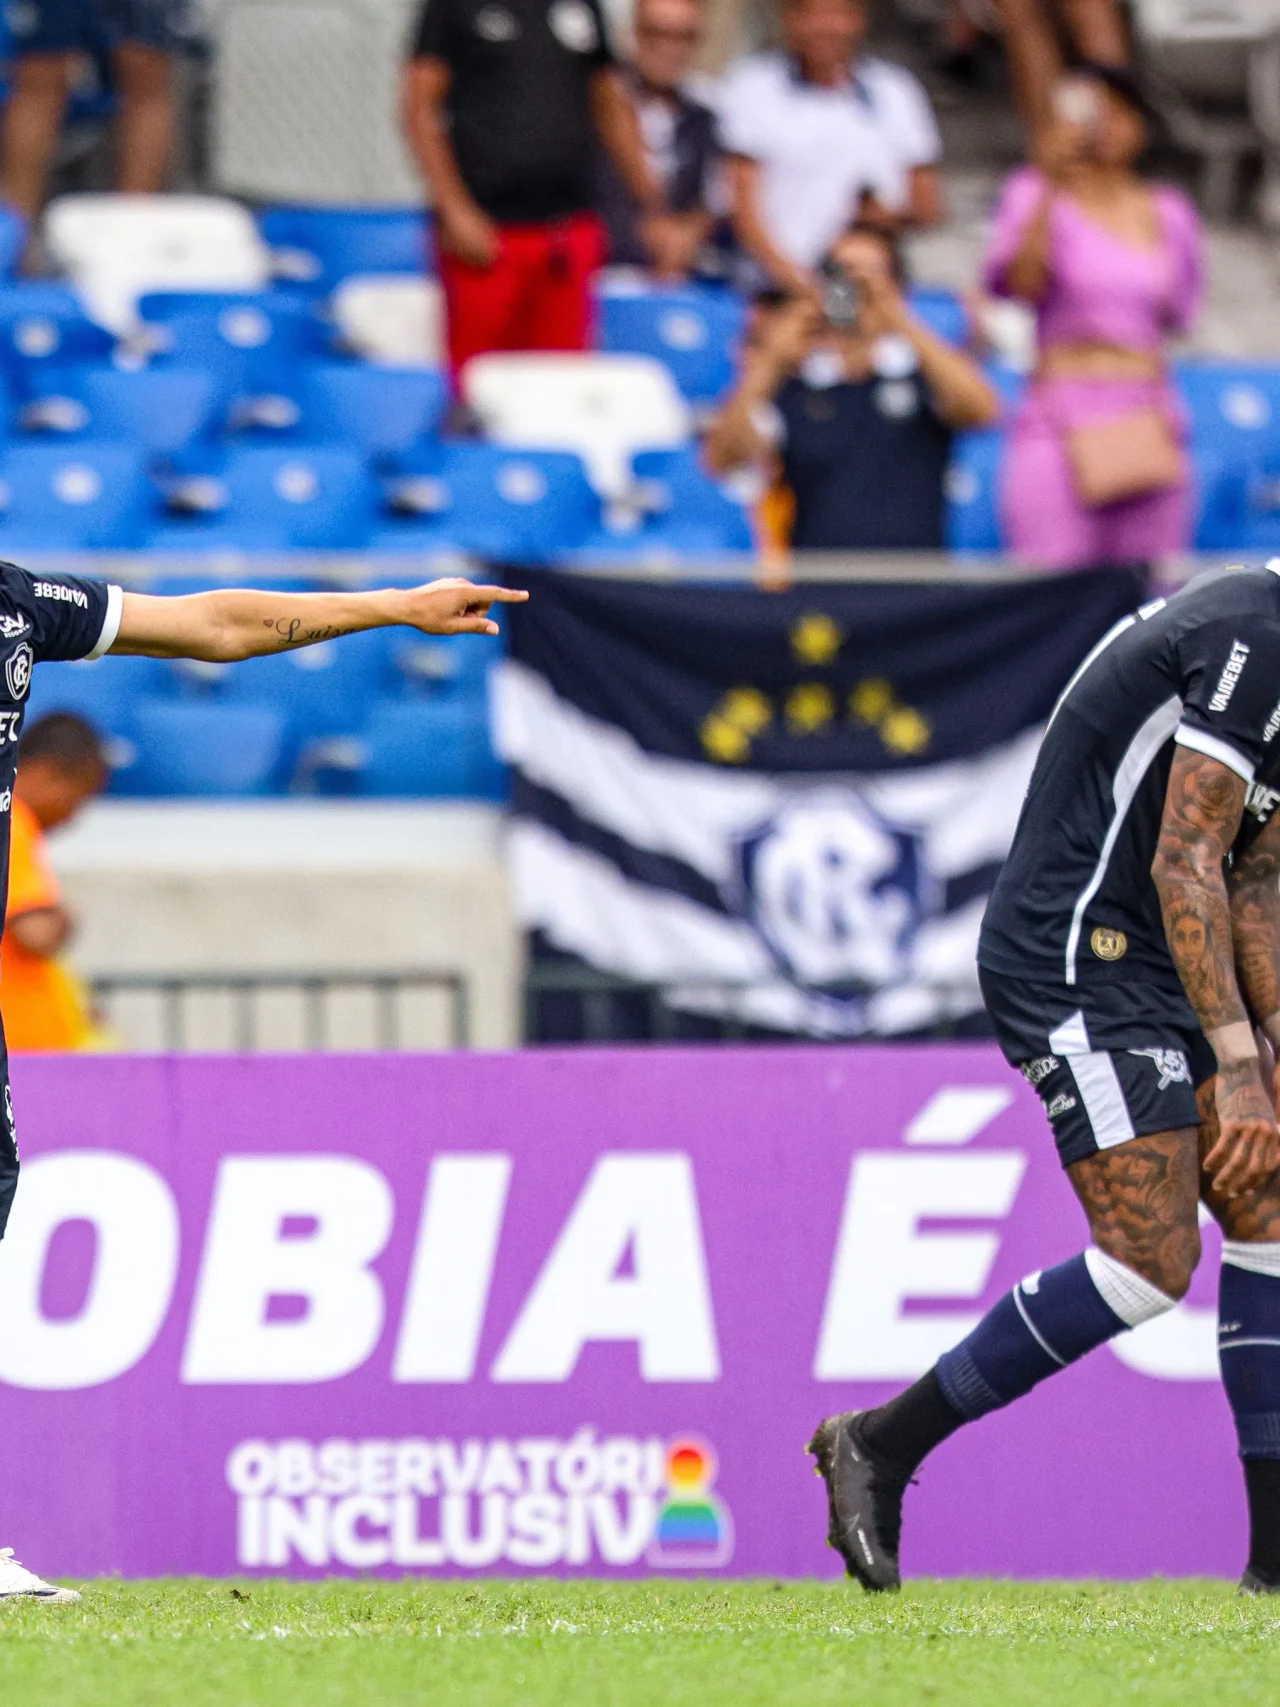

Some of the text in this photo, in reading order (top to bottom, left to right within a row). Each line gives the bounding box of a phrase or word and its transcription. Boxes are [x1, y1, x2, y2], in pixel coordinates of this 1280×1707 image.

[33, 582, 88, 609] VAIDEBE
[1208, 638, 1250, 712] VAIDEBET
[812, 1085, 1029, 1383] É
